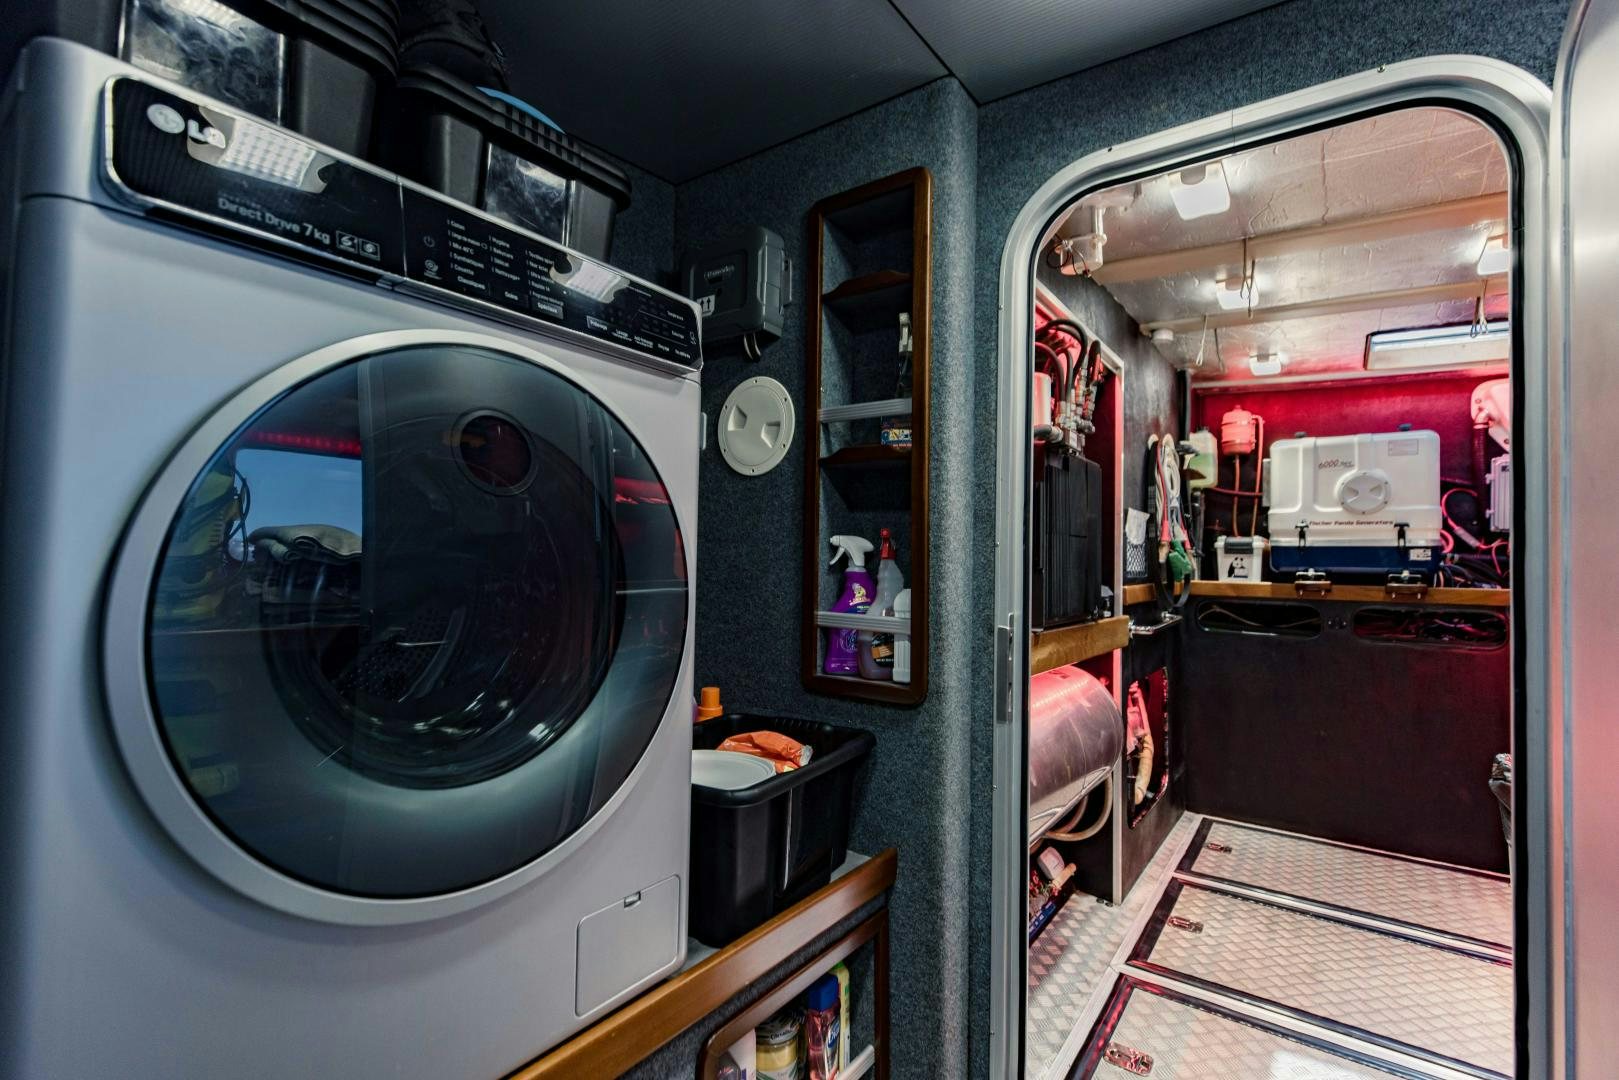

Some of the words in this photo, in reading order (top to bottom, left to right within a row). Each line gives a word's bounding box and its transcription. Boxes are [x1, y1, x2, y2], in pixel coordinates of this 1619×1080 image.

[188, 119, 226, 149] LG
[218, 198, 263, 222] Direct
[265, 212, 301, 233] Drive
[1318, 459, 1339, 469] 6000
